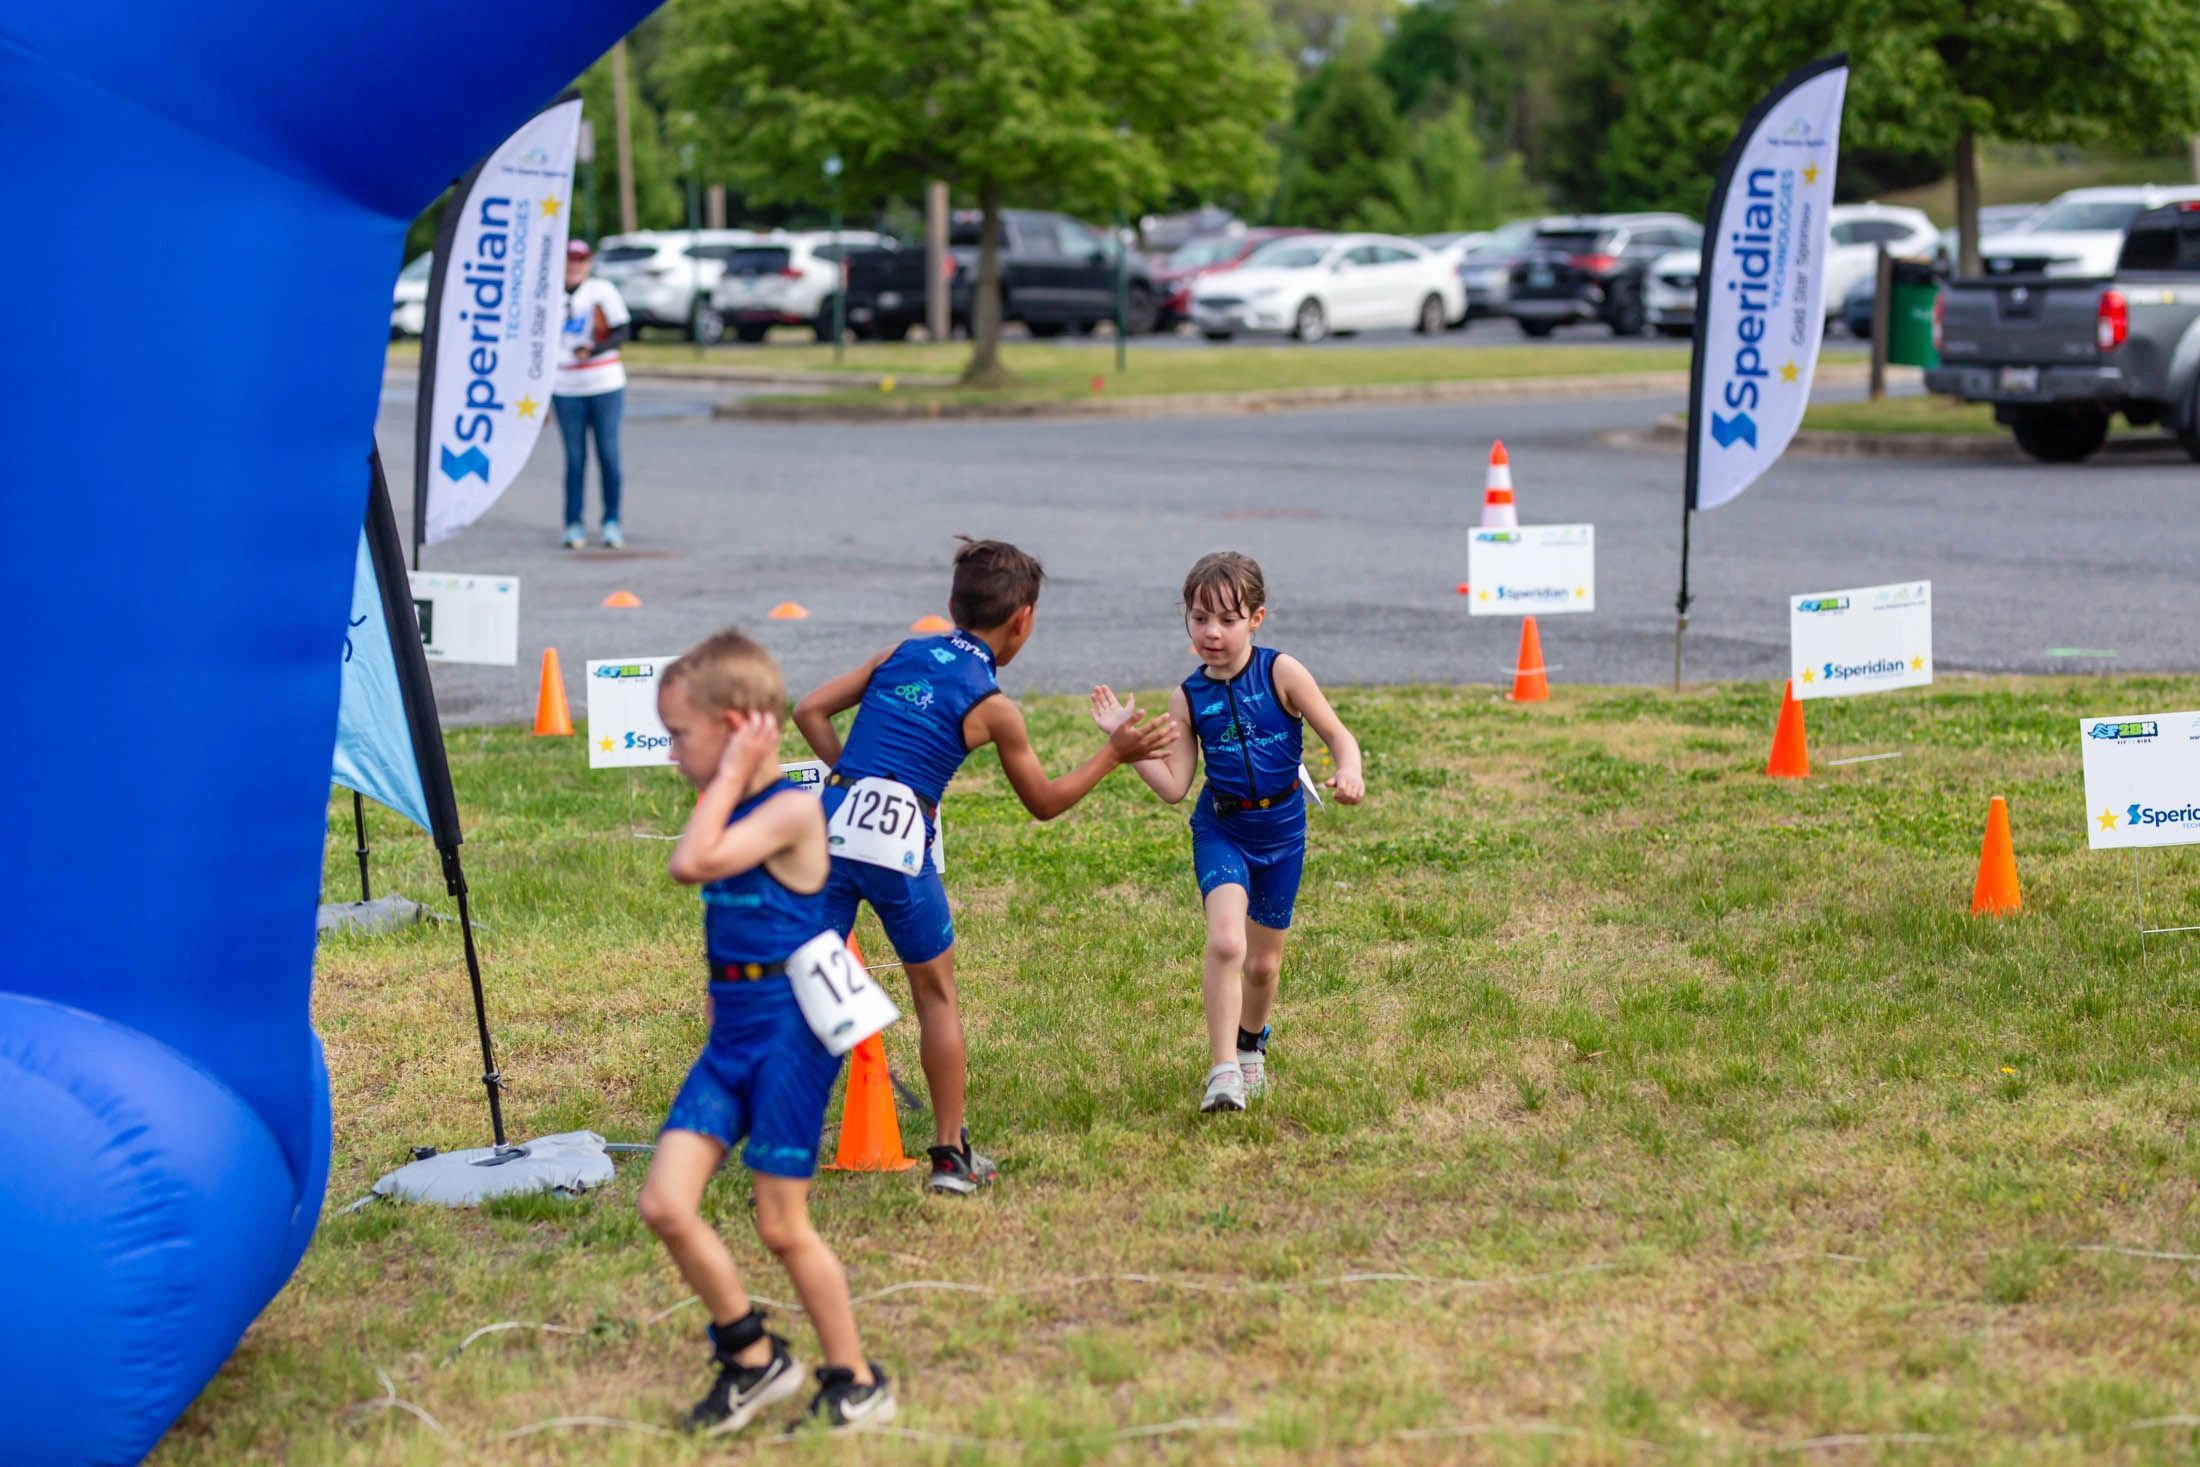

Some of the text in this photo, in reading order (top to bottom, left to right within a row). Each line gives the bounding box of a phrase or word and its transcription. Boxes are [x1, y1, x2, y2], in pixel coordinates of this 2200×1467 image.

[507, 198, 530, 340] TECHNOLOGIES
[1725, 168, 1777, 410] Speridian
[456, 196, 512, 444] Speridian
[1834, 659, 1904, 681] Speridian
[1255, 731, 1288, 747] Sports
[786, 768, 820, 785] BK
[846, 789, 917, 840] 1257
